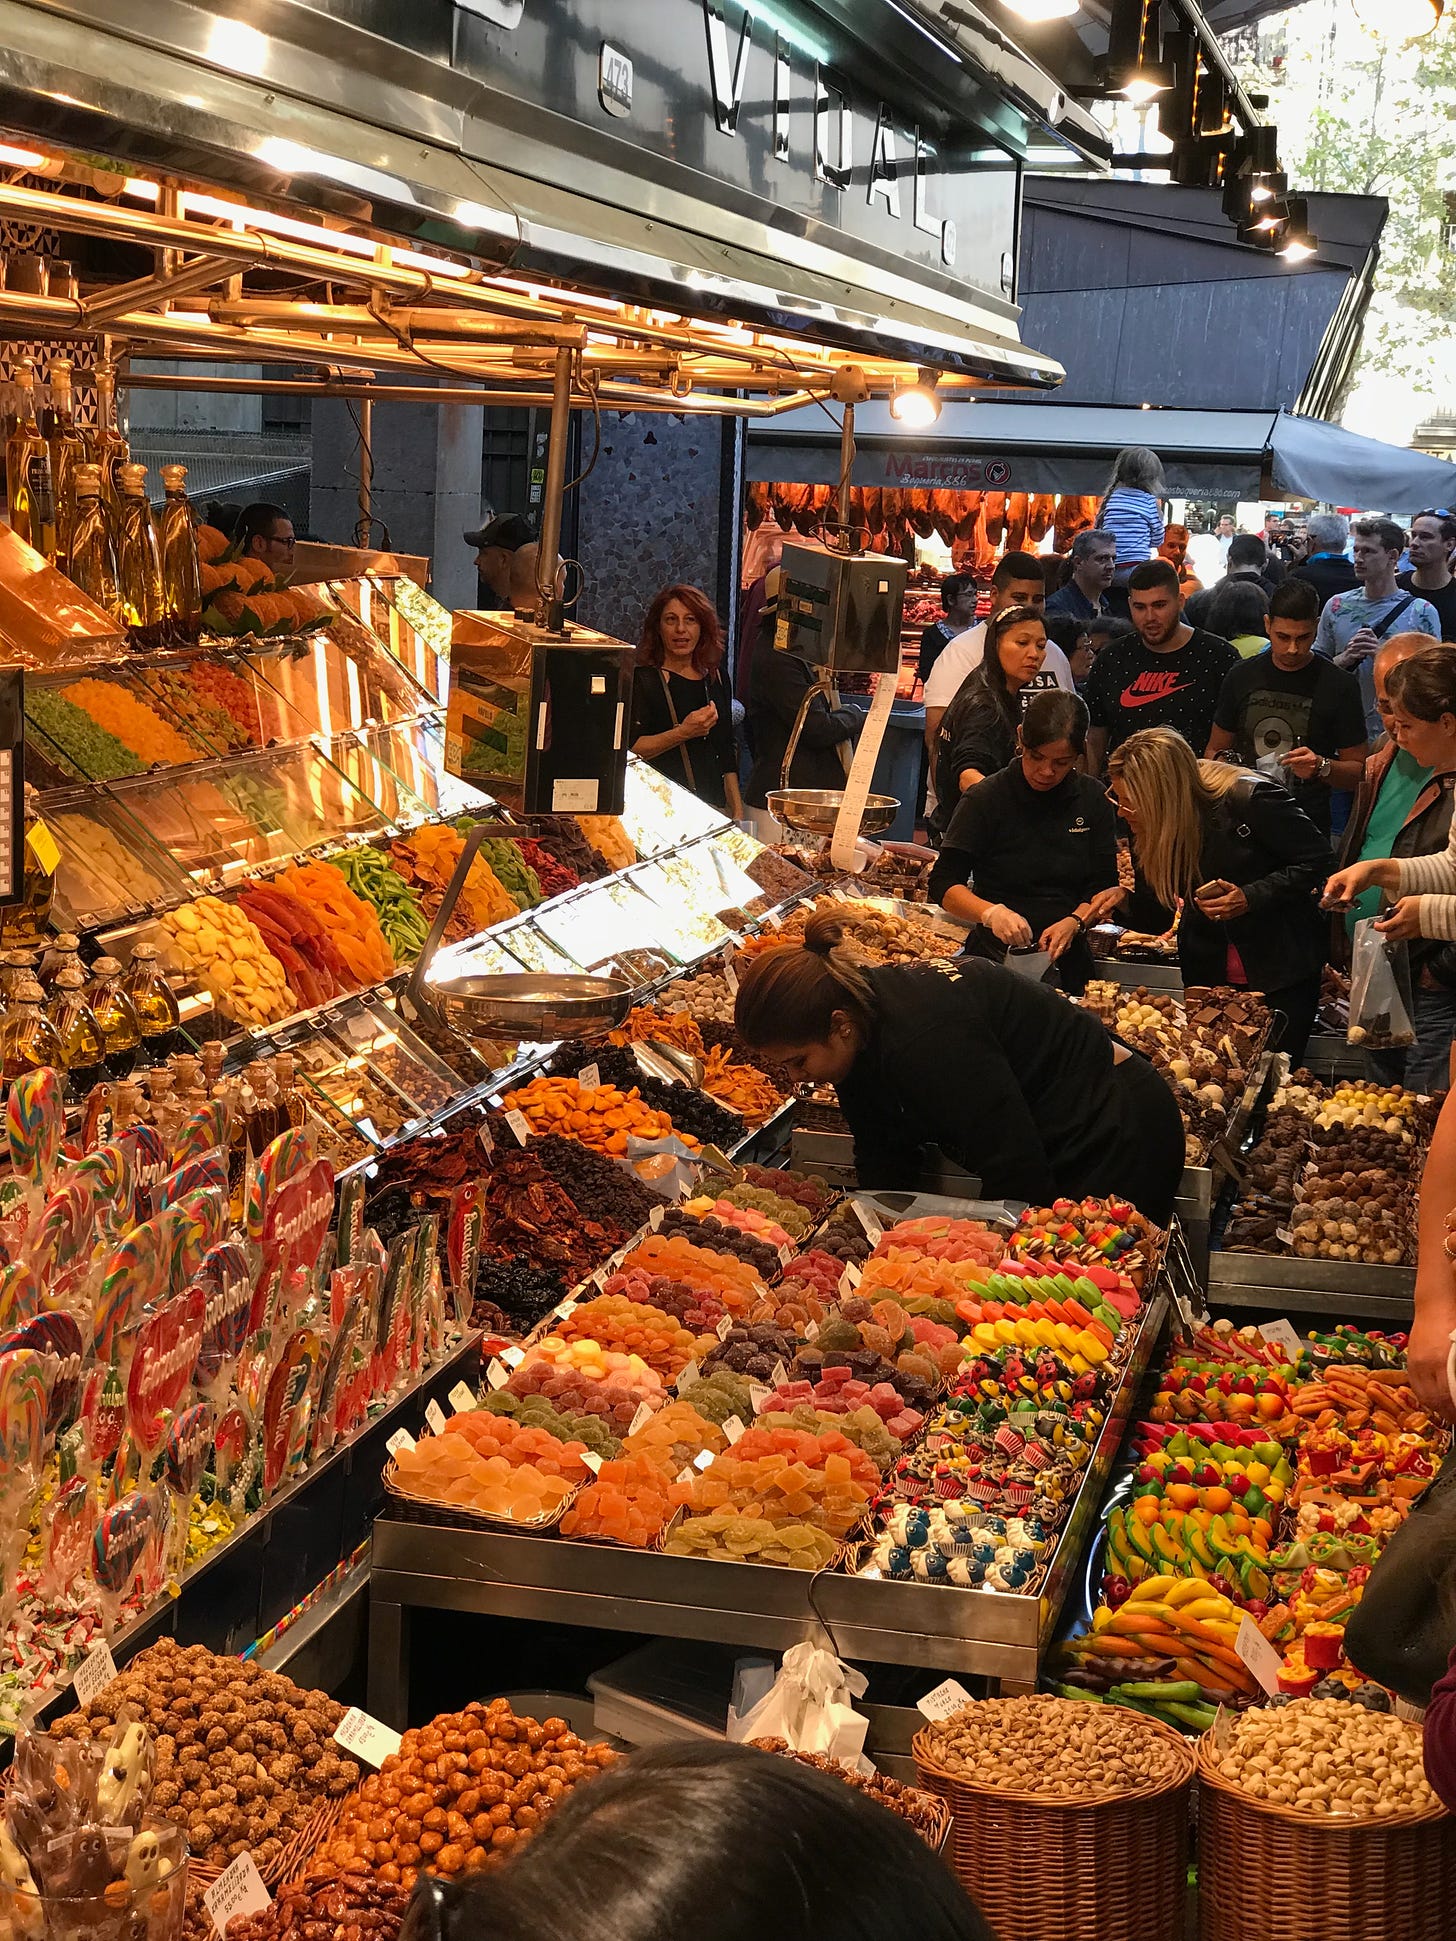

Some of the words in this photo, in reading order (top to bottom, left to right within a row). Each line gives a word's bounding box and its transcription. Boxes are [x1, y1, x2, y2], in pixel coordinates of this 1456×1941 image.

[606, 57, 629, 99] 473
[703, 0, 940, 239] VIDAL
[885, 453, 980, 481] Marcos
[1132, 672, 1180, 692] NIKE
[460, 1211, 478, 1289] Barcelona
